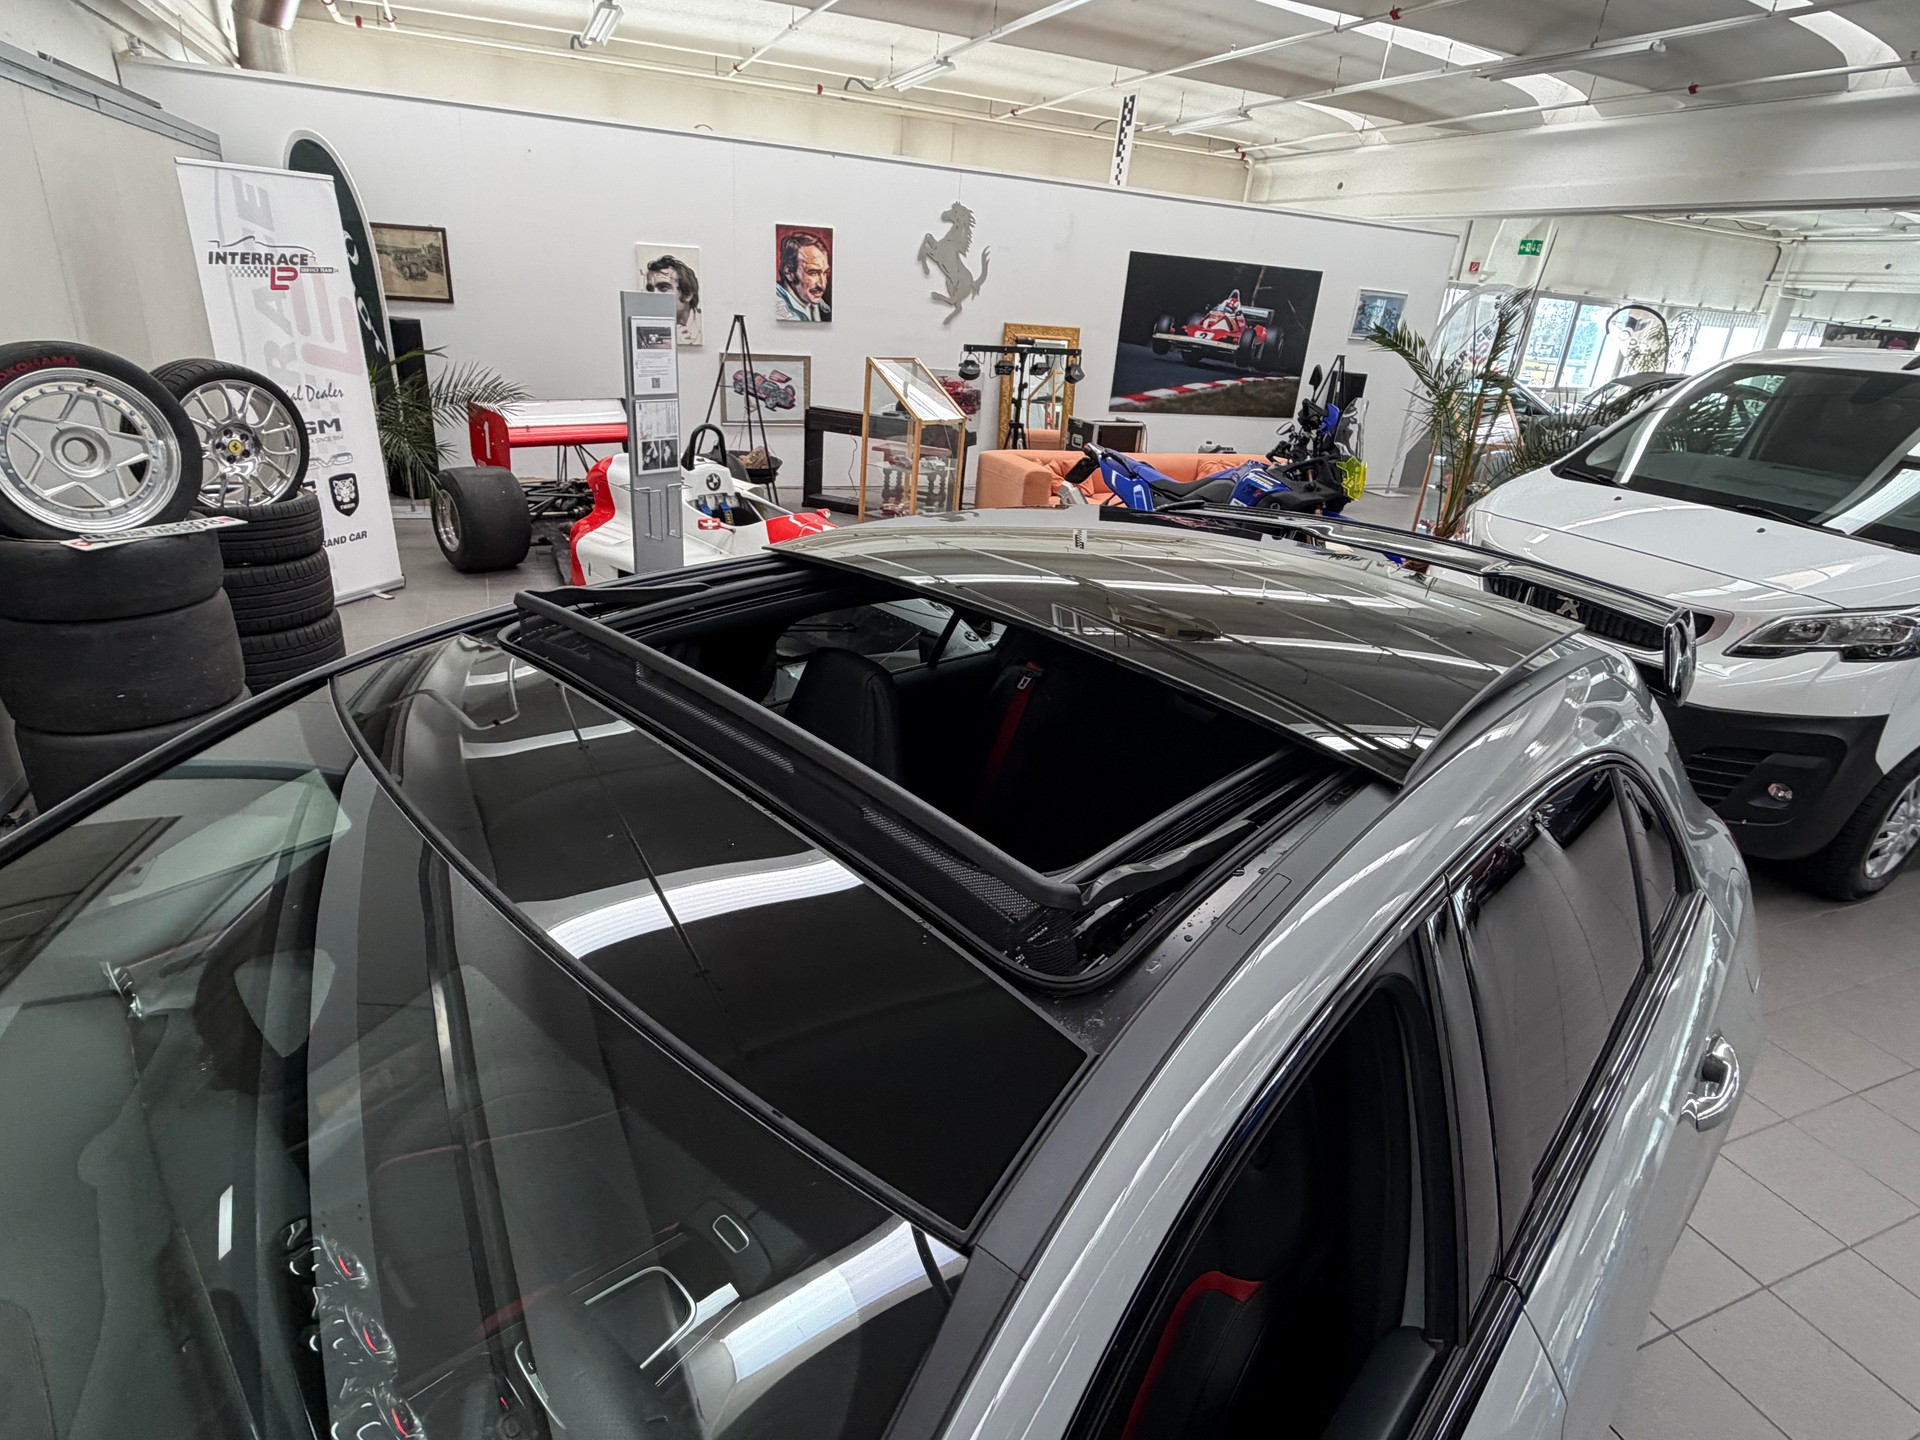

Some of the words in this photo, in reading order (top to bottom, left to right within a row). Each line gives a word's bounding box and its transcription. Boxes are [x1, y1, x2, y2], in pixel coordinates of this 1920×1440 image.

[208, 251, 308, 266] INTERRACE
[305, 382, 344, 402] Dealer
[304, 417, 342, 436] GM
[483, 421, 492, 459] 1
[349, 530, 368, 542] CAR
